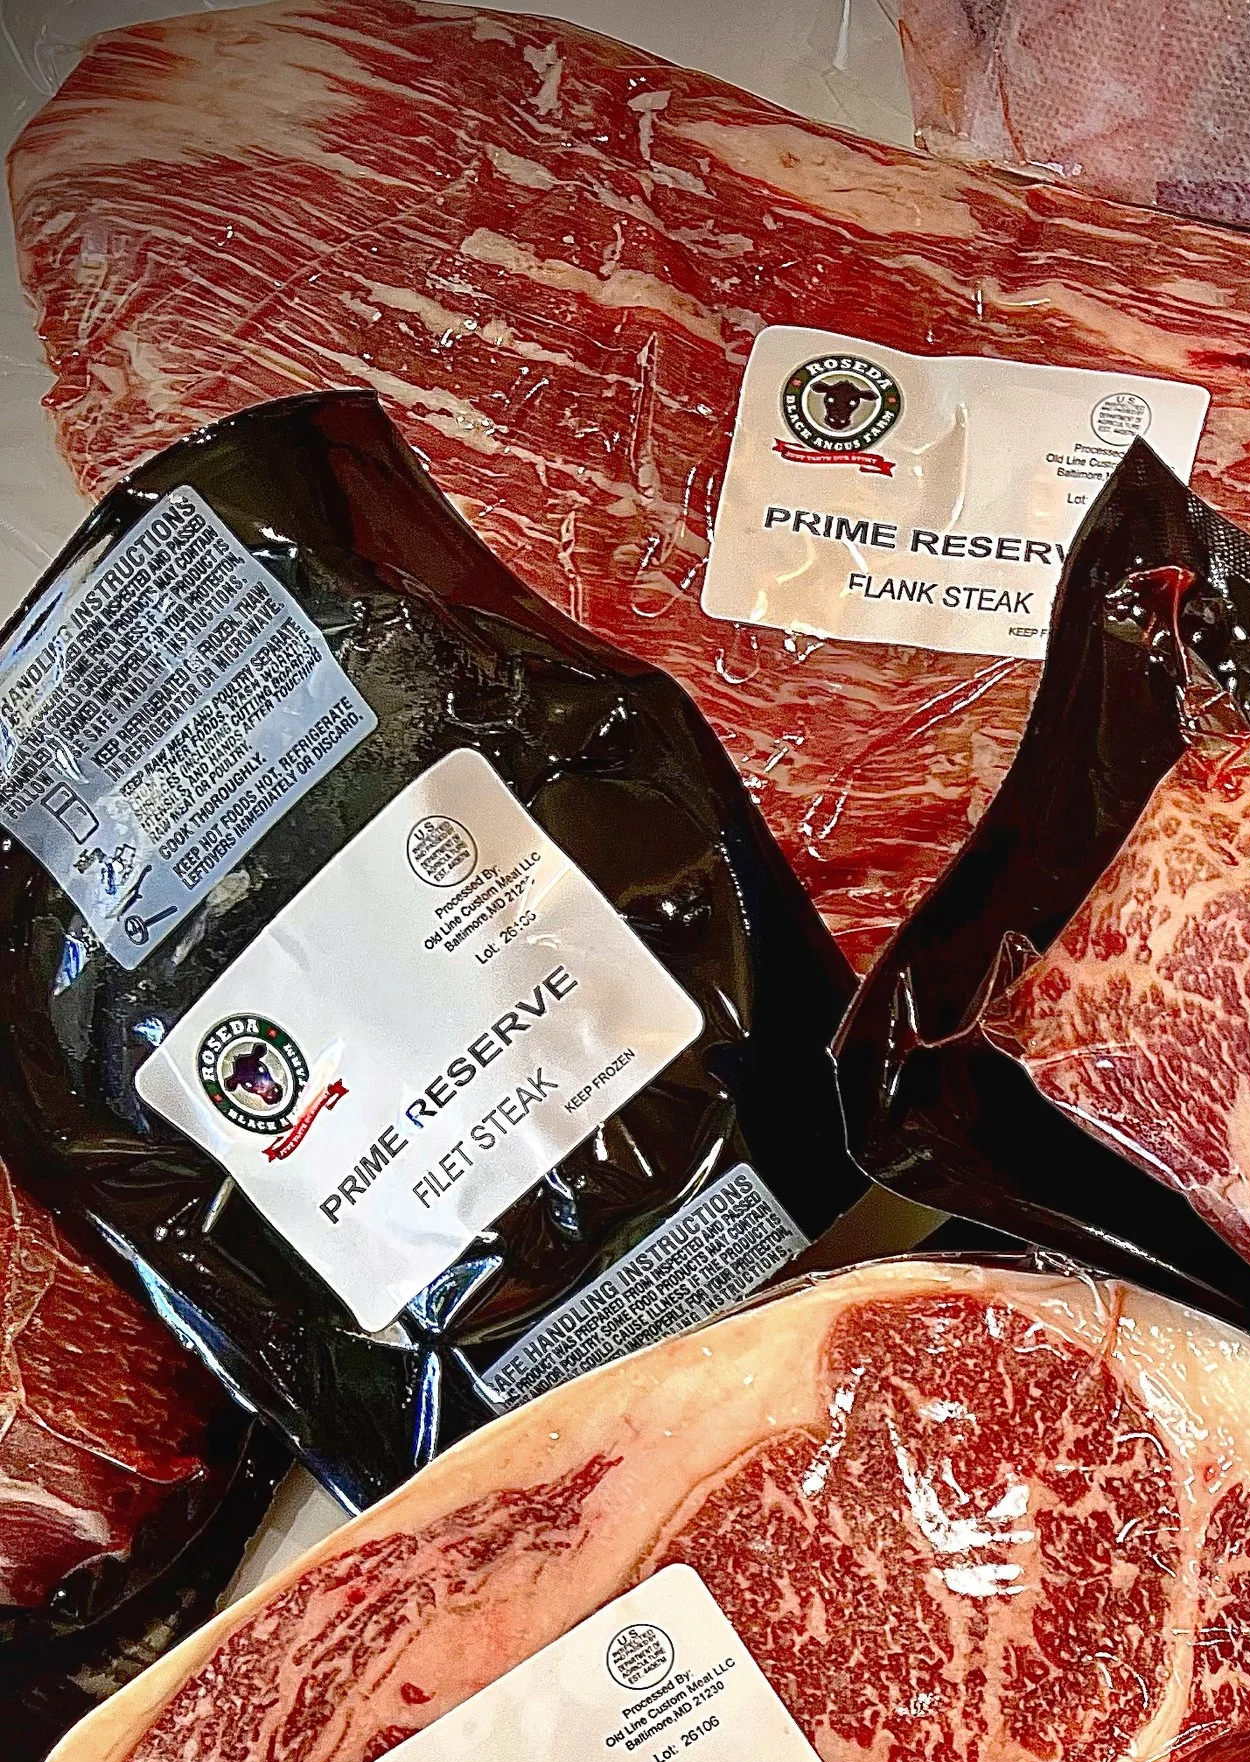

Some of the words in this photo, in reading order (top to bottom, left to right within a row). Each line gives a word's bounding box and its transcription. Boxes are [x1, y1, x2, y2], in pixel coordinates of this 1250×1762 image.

[804, 357, 894, 392] ROSEDA
[765, 507, 897, 549] PRIME
[70, 497, 196, 630] INSTRUCTIONS
[849, 573, 938, 604] FLANK
[943, 586, 1034, 614] STEAK
[1009, 627, 1038, 637] KEEP
[158, 823, 194, 860] COOK
[189, 751, 267, 830] THOROUGHLY.
[173, 848, 201, 879] KEEP
[199, 823, 223, 853] HOT
[221, 791, 258, 828] FOODS
[279, 696, 354, 770] REFRIGERATE
[181, 832, 236, 890] LEFTOVERS
[237, 771, 299, 839] IMMEDIATELY
[298, 757, 316, 775] OR
[435, 873, 484, 919] Processed
[202, 1018, 261, 1083] ROSEDA
[564, 1083, 597, 1114] KEEP
[592, 1049, 635, 1089] FROZEN
[319, 1125, 408, 1224] PRIME
[406, 966, 578, 1128] RESERVE
[412, 1141, 473, 1208] FILET
[471, 1068, 558, 1149] STEAK
[525, 1279, 619, 1364] HANDLING
[616, 1174, 754, 1287] INSTRUCTIONS
[622, 1680, 675, 1719] Processed
[693, 1681, 724, 1706] 21230
[681, 1716, 719, 1747] 26106
